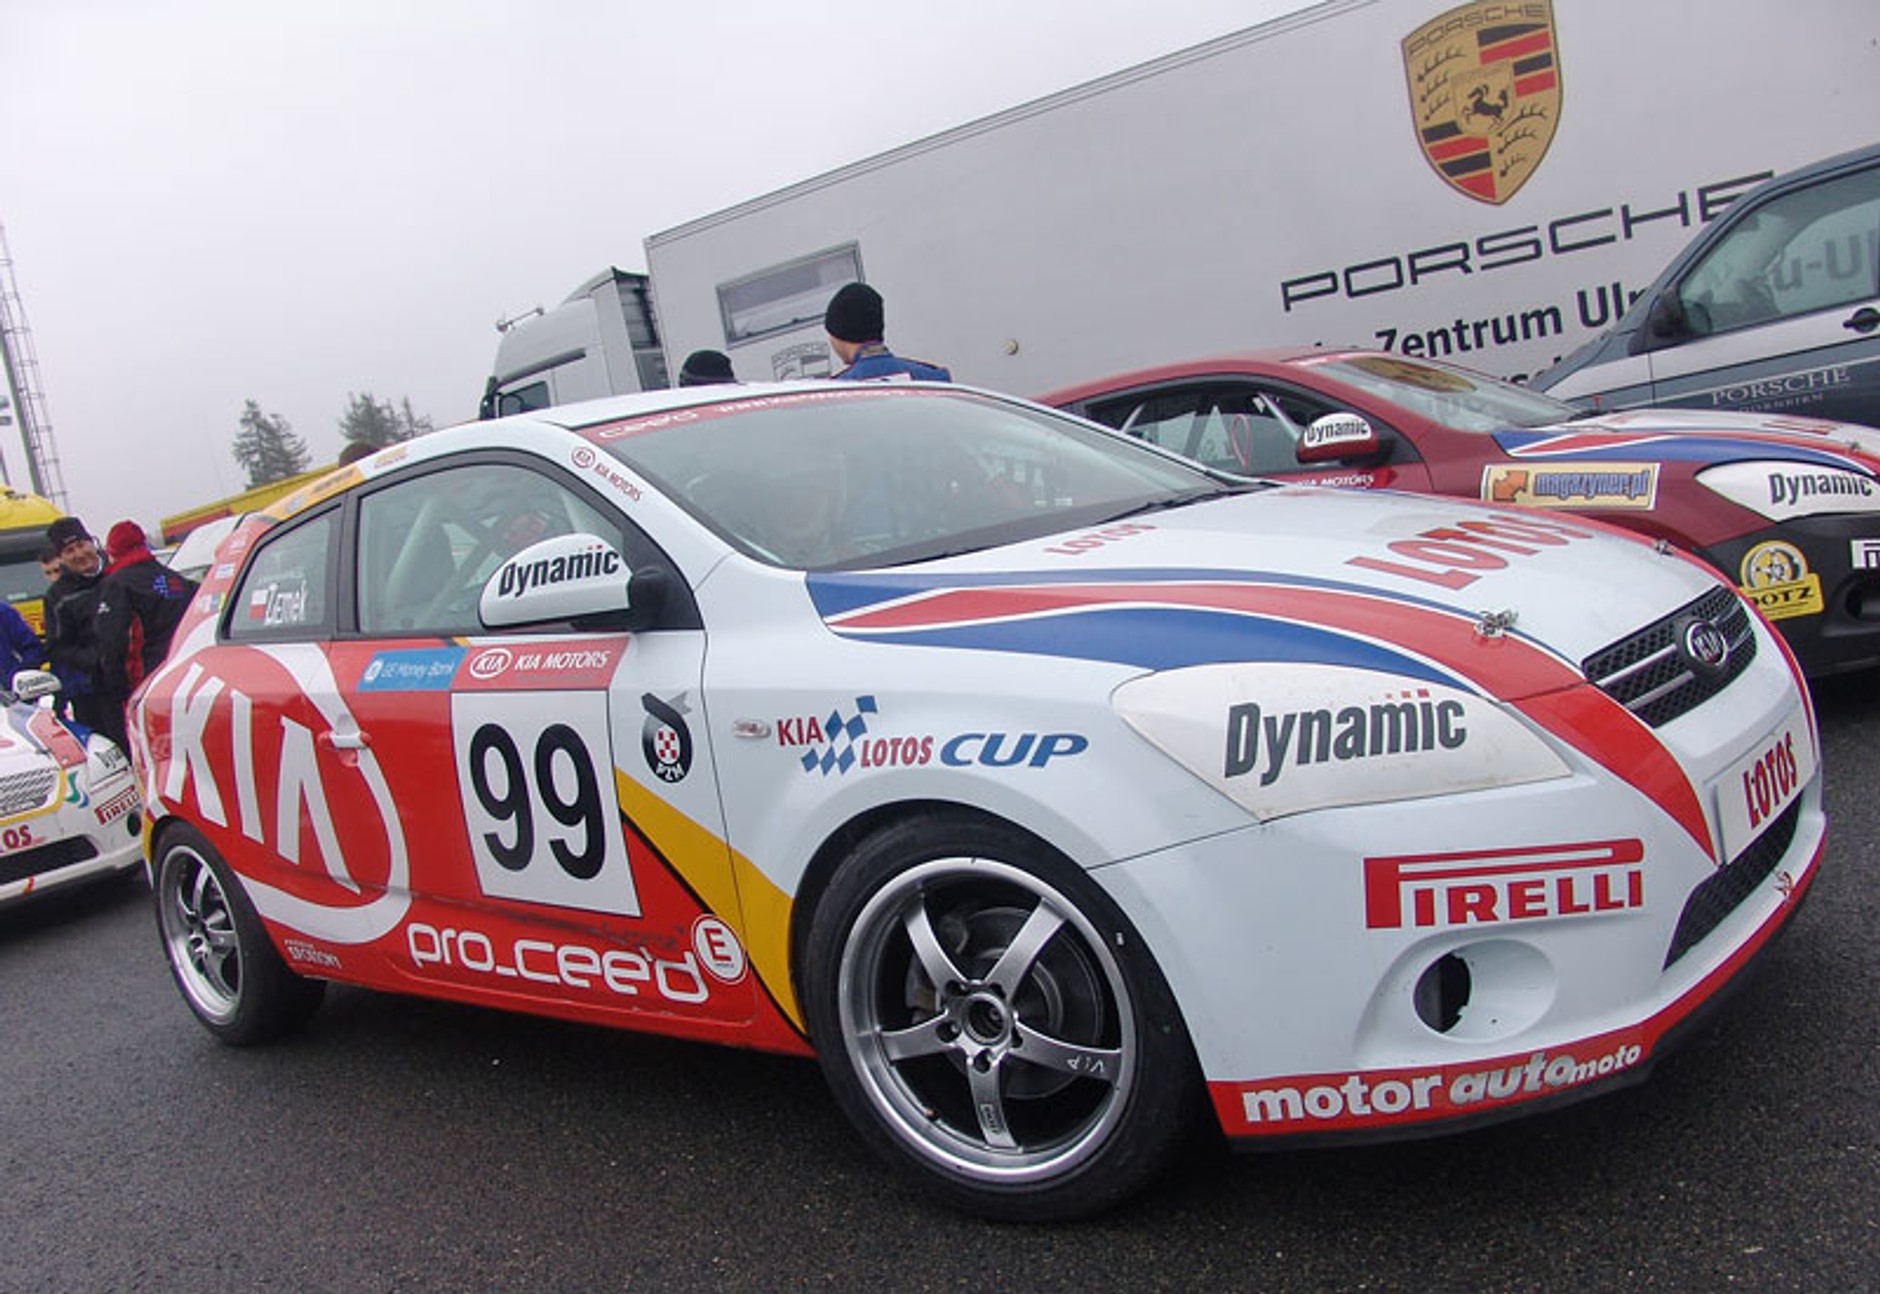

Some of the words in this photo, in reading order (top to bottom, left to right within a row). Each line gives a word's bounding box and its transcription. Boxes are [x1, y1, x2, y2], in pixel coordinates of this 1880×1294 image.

[1408, 3, 1545, 56] PORSCHE
[1281, 170, 1775, 312] PORSCHE
[1375, 303, 1563, 361] Zentrum
[1711, 367, 1851, 406] PORSCHE
[1307, 421, 1368, 442] Dynamic
[1767, 472, 1873, 506] Dynamic
[498, 544, 620, 598] Dynamic
[1342, 514, 1594, 591] LOTOS
[515, 653, 539, 671] KIA
[543, 650, 612, 670] MOTORS
[776, 716, 825, 746] KIA
[860, 735, 934, 768] LOTOS
[940, 732, 1089, 768] CUP
[1224, 688, 1468, 786] Dynamic
[163, 661, 362, 896] KIA
[469, 722, 607, 881] 99
[1742, 730, 1798, 830] LOTOS
[1363, 838, 1645, 930] PIRELLI
[1241, 1075, 1443, 1123] motor
